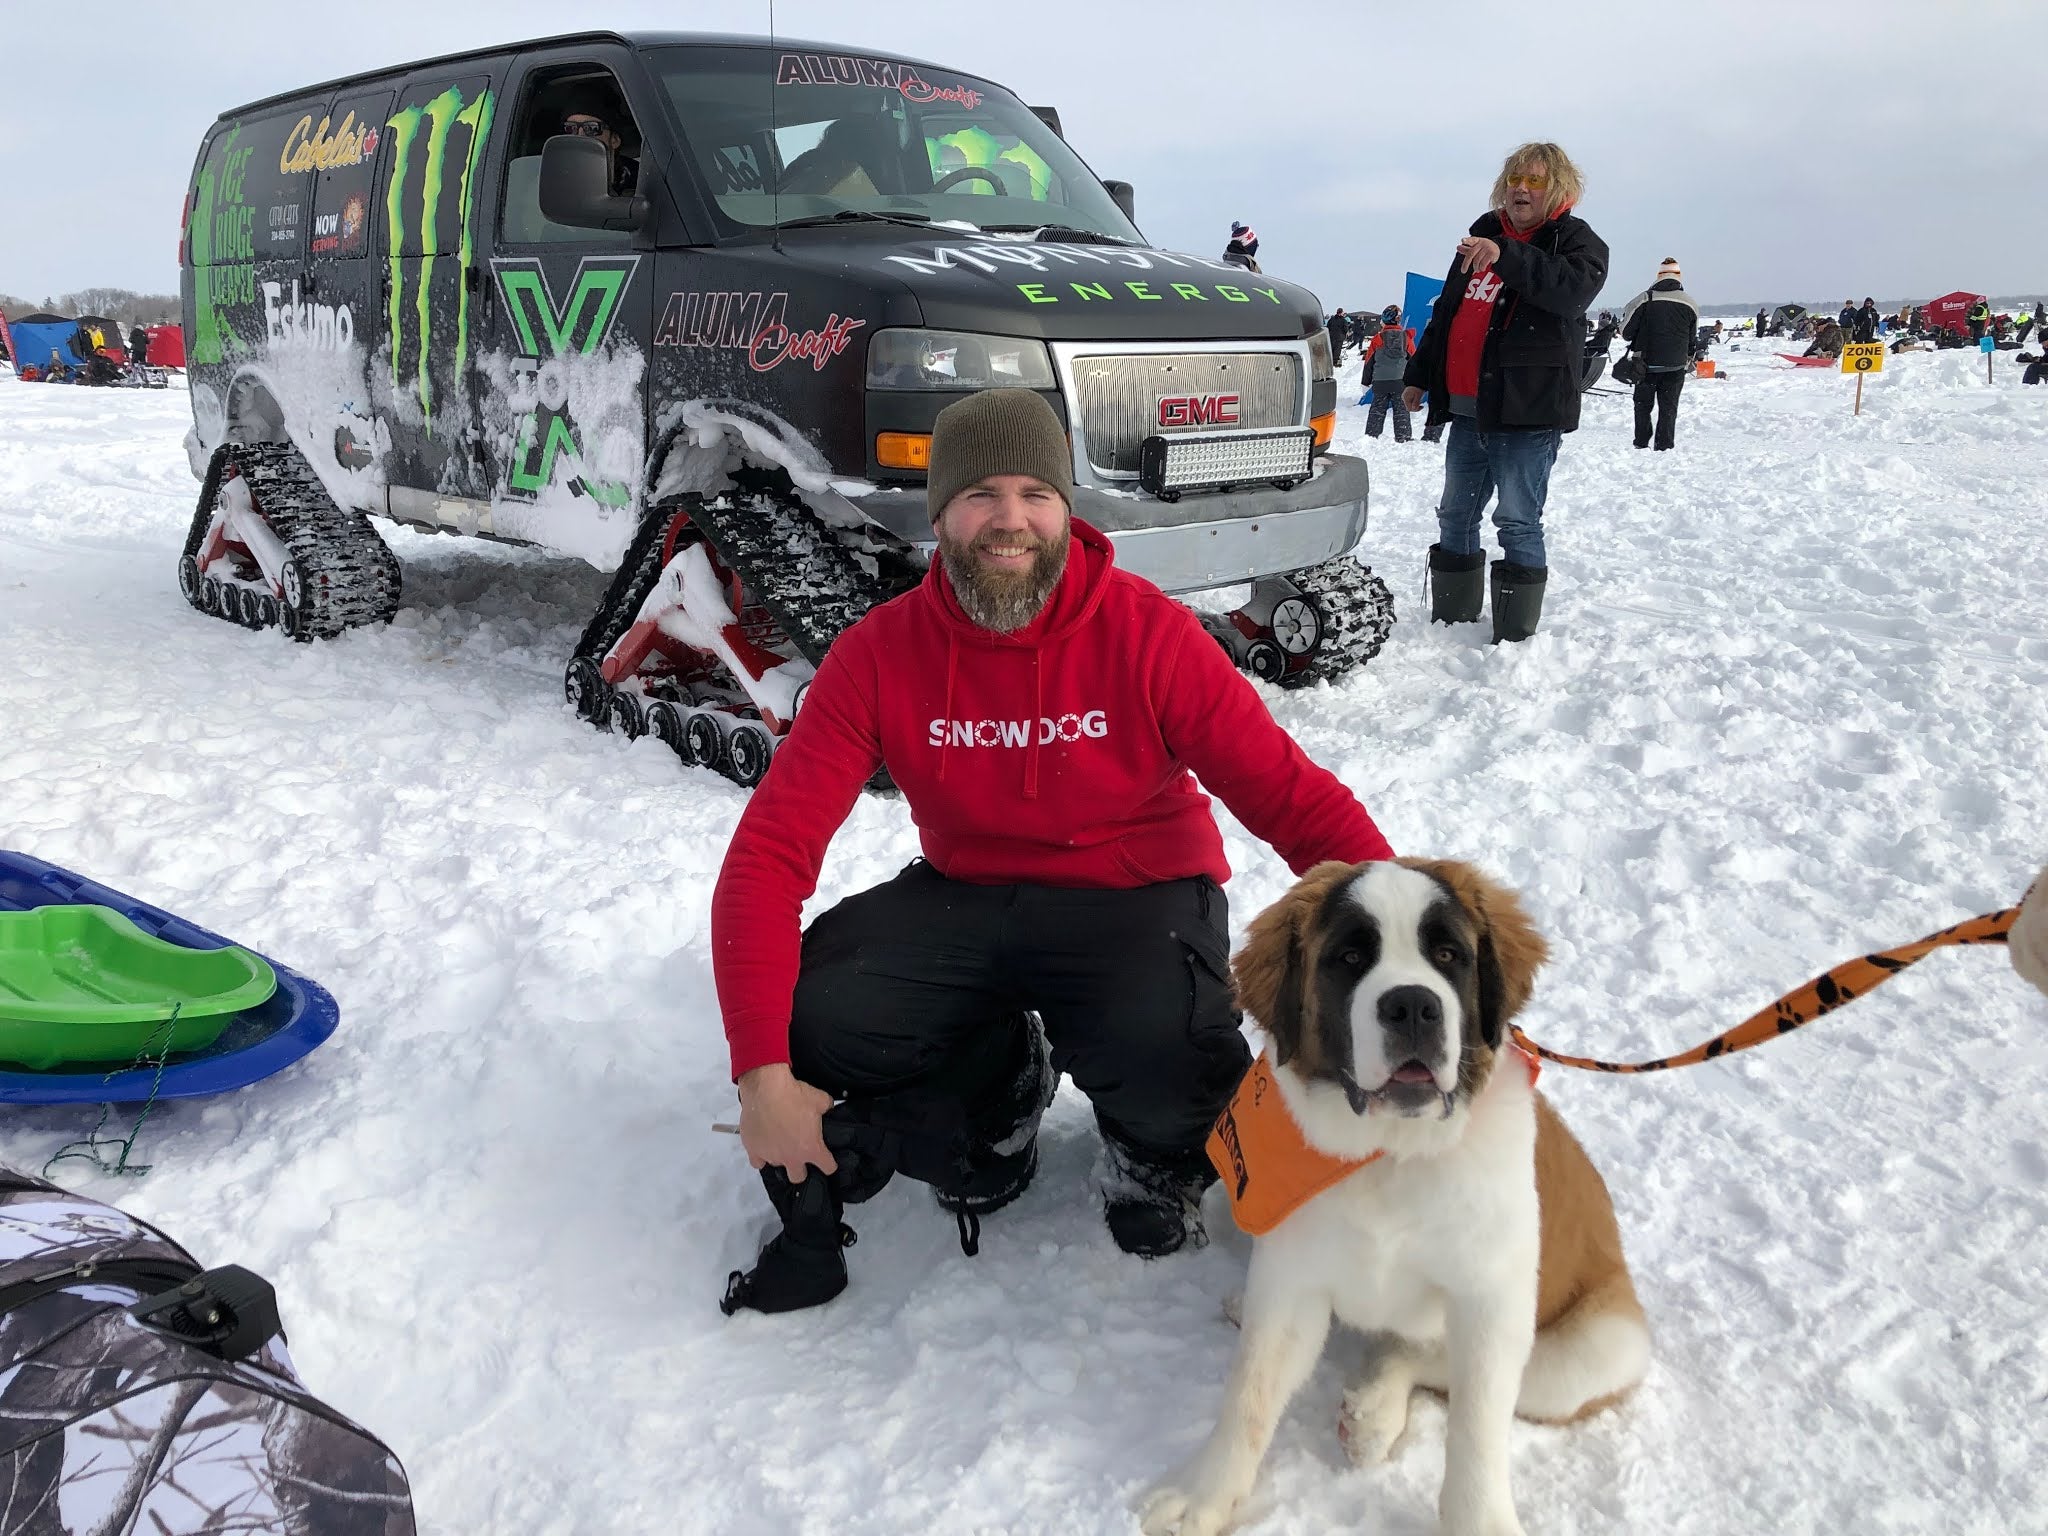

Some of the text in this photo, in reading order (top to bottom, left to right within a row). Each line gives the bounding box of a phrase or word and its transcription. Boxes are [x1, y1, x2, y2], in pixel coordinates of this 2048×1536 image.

[776, 55, 985, 110] ALUMA Craft
[280, 110, 366, 174] Cabela's
[315, 213, 339, 236] NOW
[313, 236, 338, 253] SERVING
[882, 243, 1256, 274] MONSTE
[1016, 281, 1281, 305] ENERGY
[262, 279, 353, 352] Eskimo
[654, 292, 867, 372] ALUMA Craft
[1846, 346, 1882, 357] ZONE
[1859, 358, 1868, 369] 6
[1158, 395, 1239, 426] GMC
[928, 710, 1108, 748] SNOWDOG
